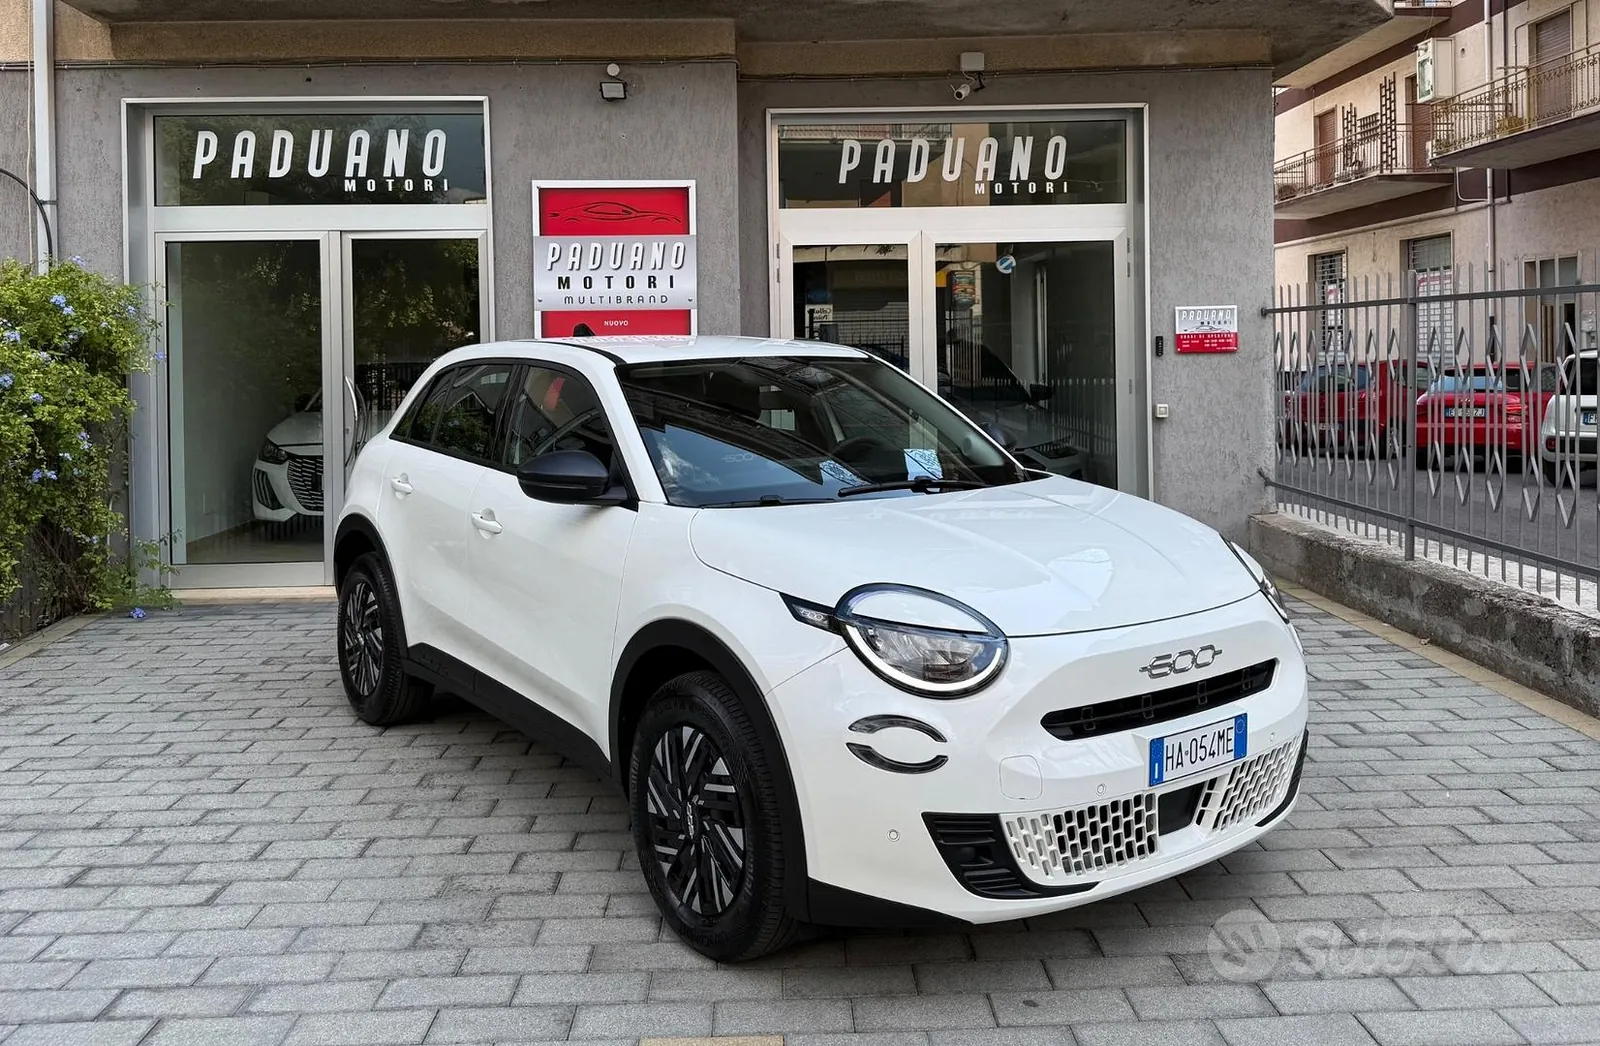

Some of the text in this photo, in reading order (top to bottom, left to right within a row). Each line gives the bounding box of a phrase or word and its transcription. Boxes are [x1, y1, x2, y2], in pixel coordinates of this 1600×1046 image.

[192, 129, 447, 179] PADUANO
[838, 135, 1068, 183] PADUANO
[344, 179, 449, 192] MOTORI
[974, 182, 1069, 195] MOTORI
[546, 242, 685, 270] PADUANO
[557, 275, 674, 290] MOTORI
[563, 295, 669, 304] MULTIBRAND
[1181, 310, 1232, 321] PADUANO
[1139, 645, 1223, 678] 600
